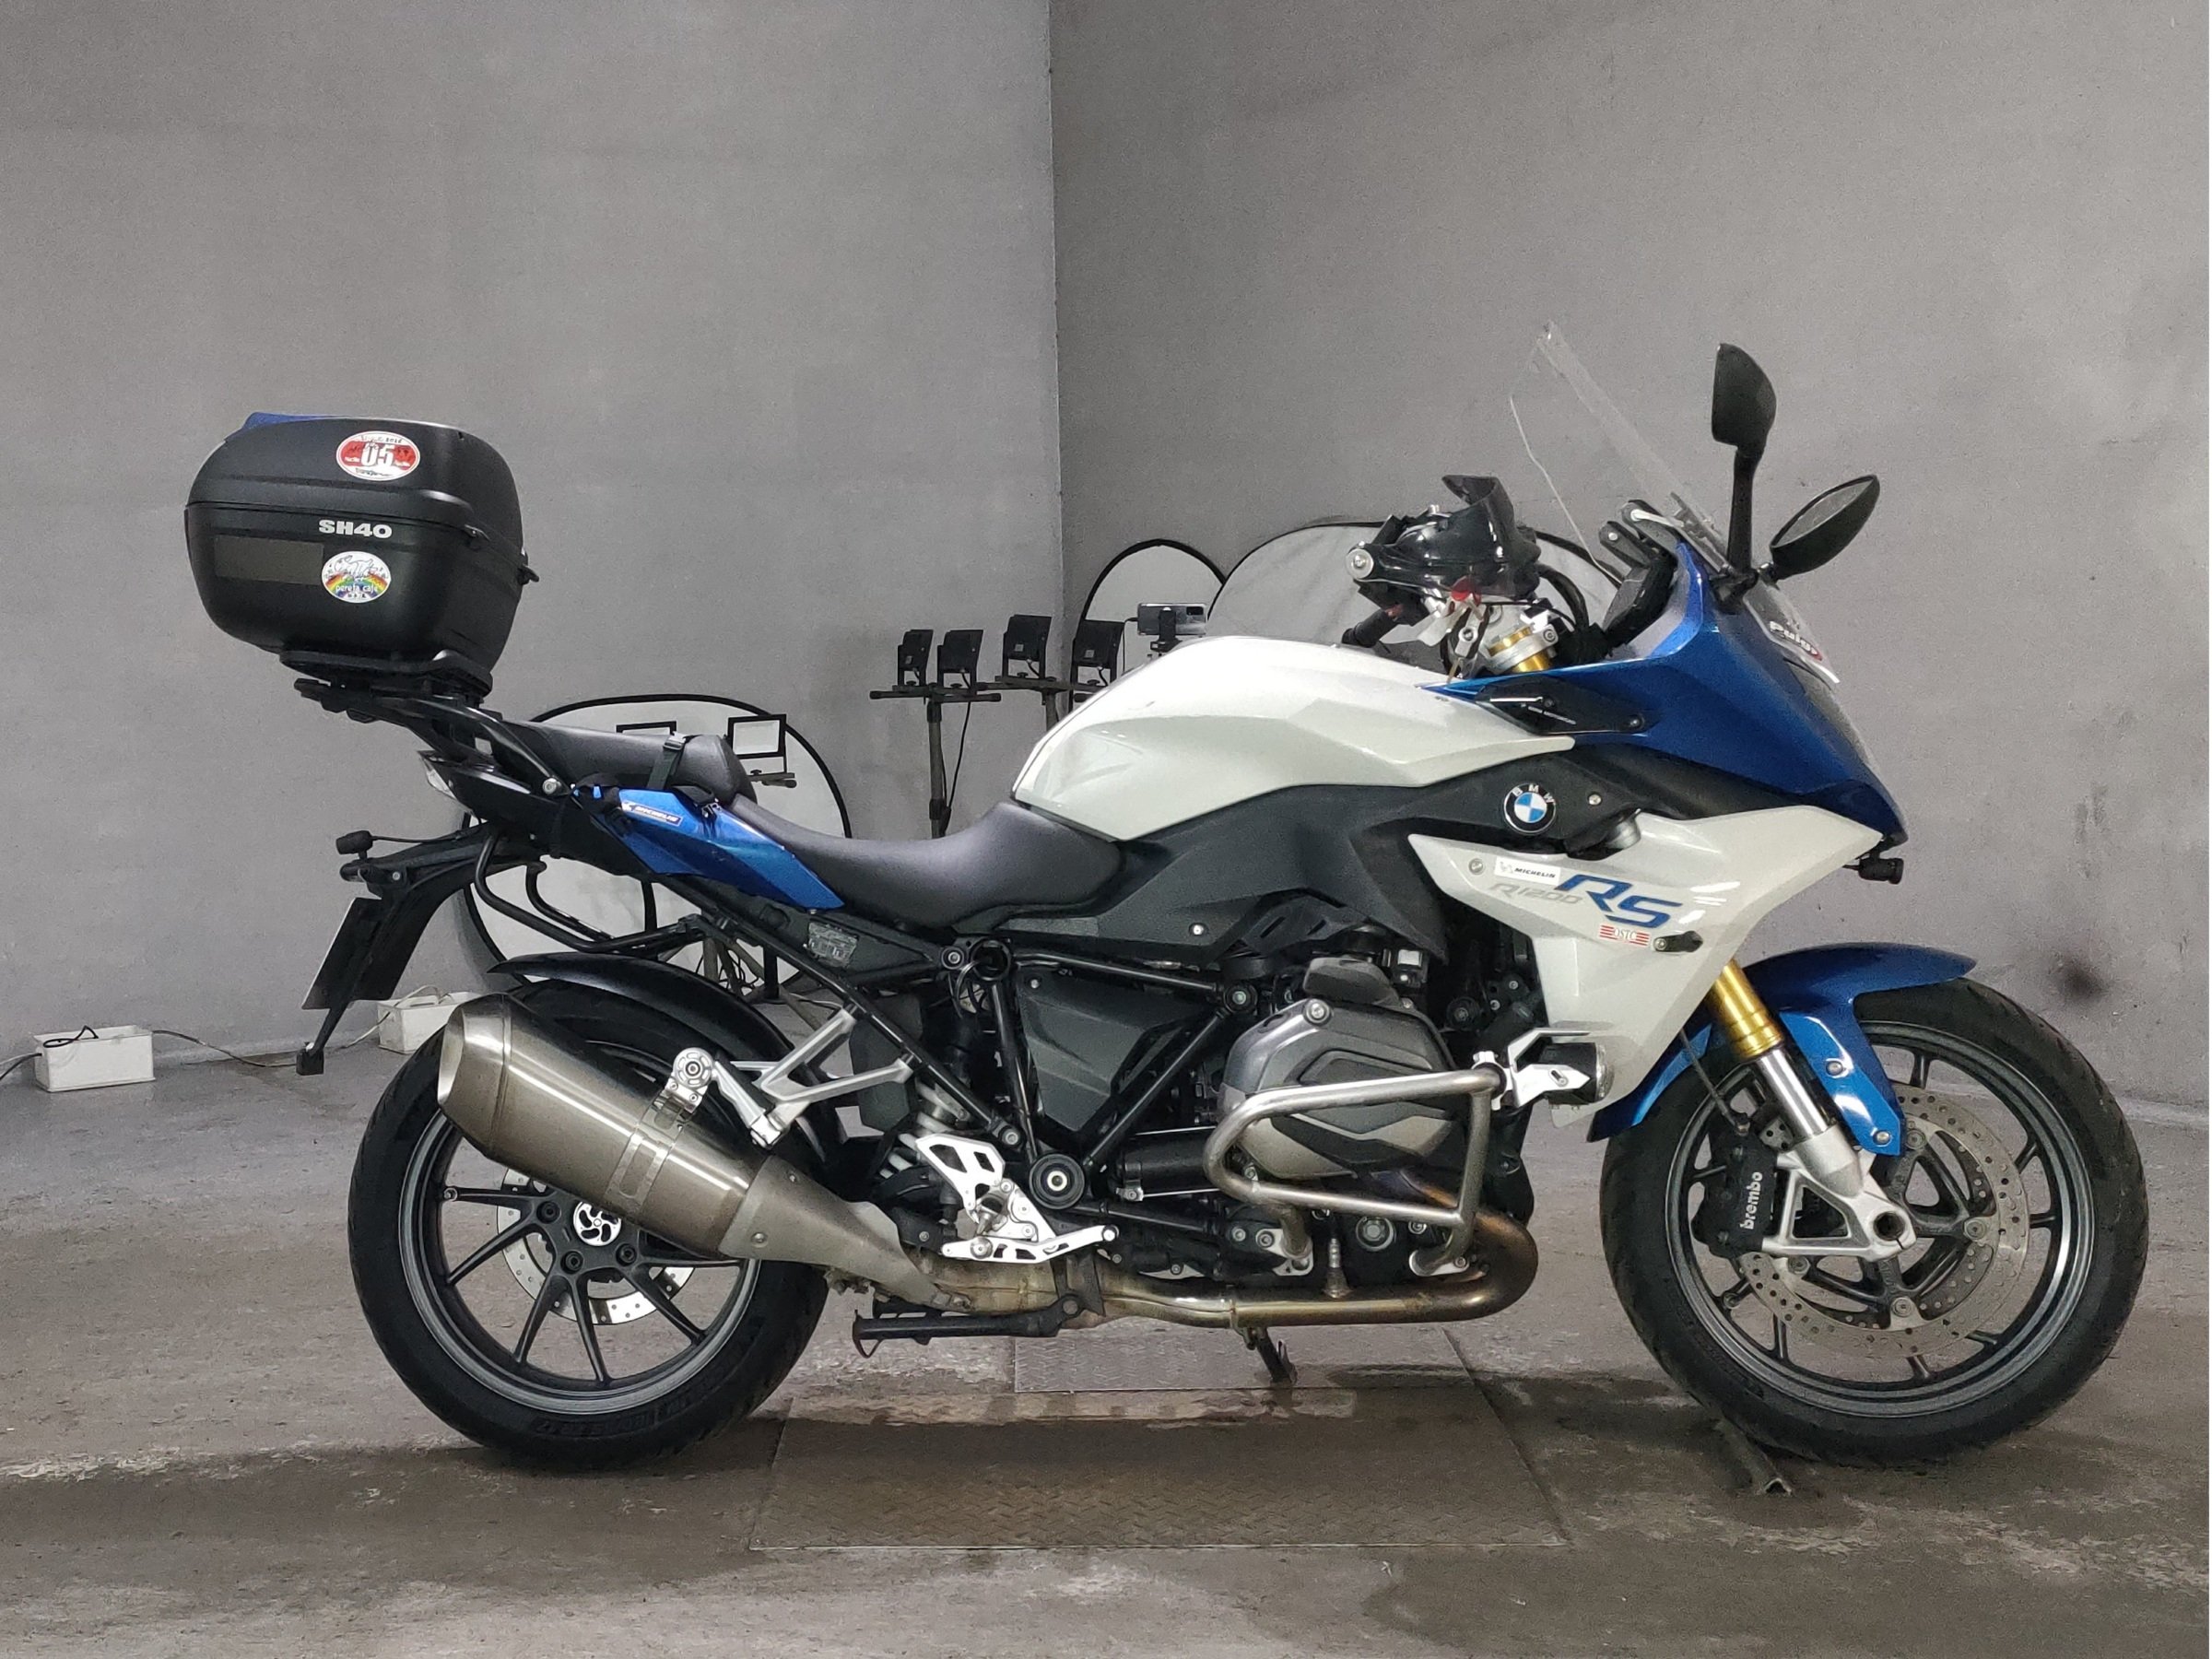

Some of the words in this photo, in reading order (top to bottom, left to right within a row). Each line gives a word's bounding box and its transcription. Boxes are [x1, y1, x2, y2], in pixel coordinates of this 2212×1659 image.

[360, 442, 395, 466] 05
[318, 519, 393, 539] SH40
[1512, 783, 1555, 803] BMW
[1514, 867, 1556, 878] MICHELIN
[1488, 882, 1583, 904] R1200
[1554, 874, 1683, 929] RS
[1739, 1171, 1763, 1230] brembo
